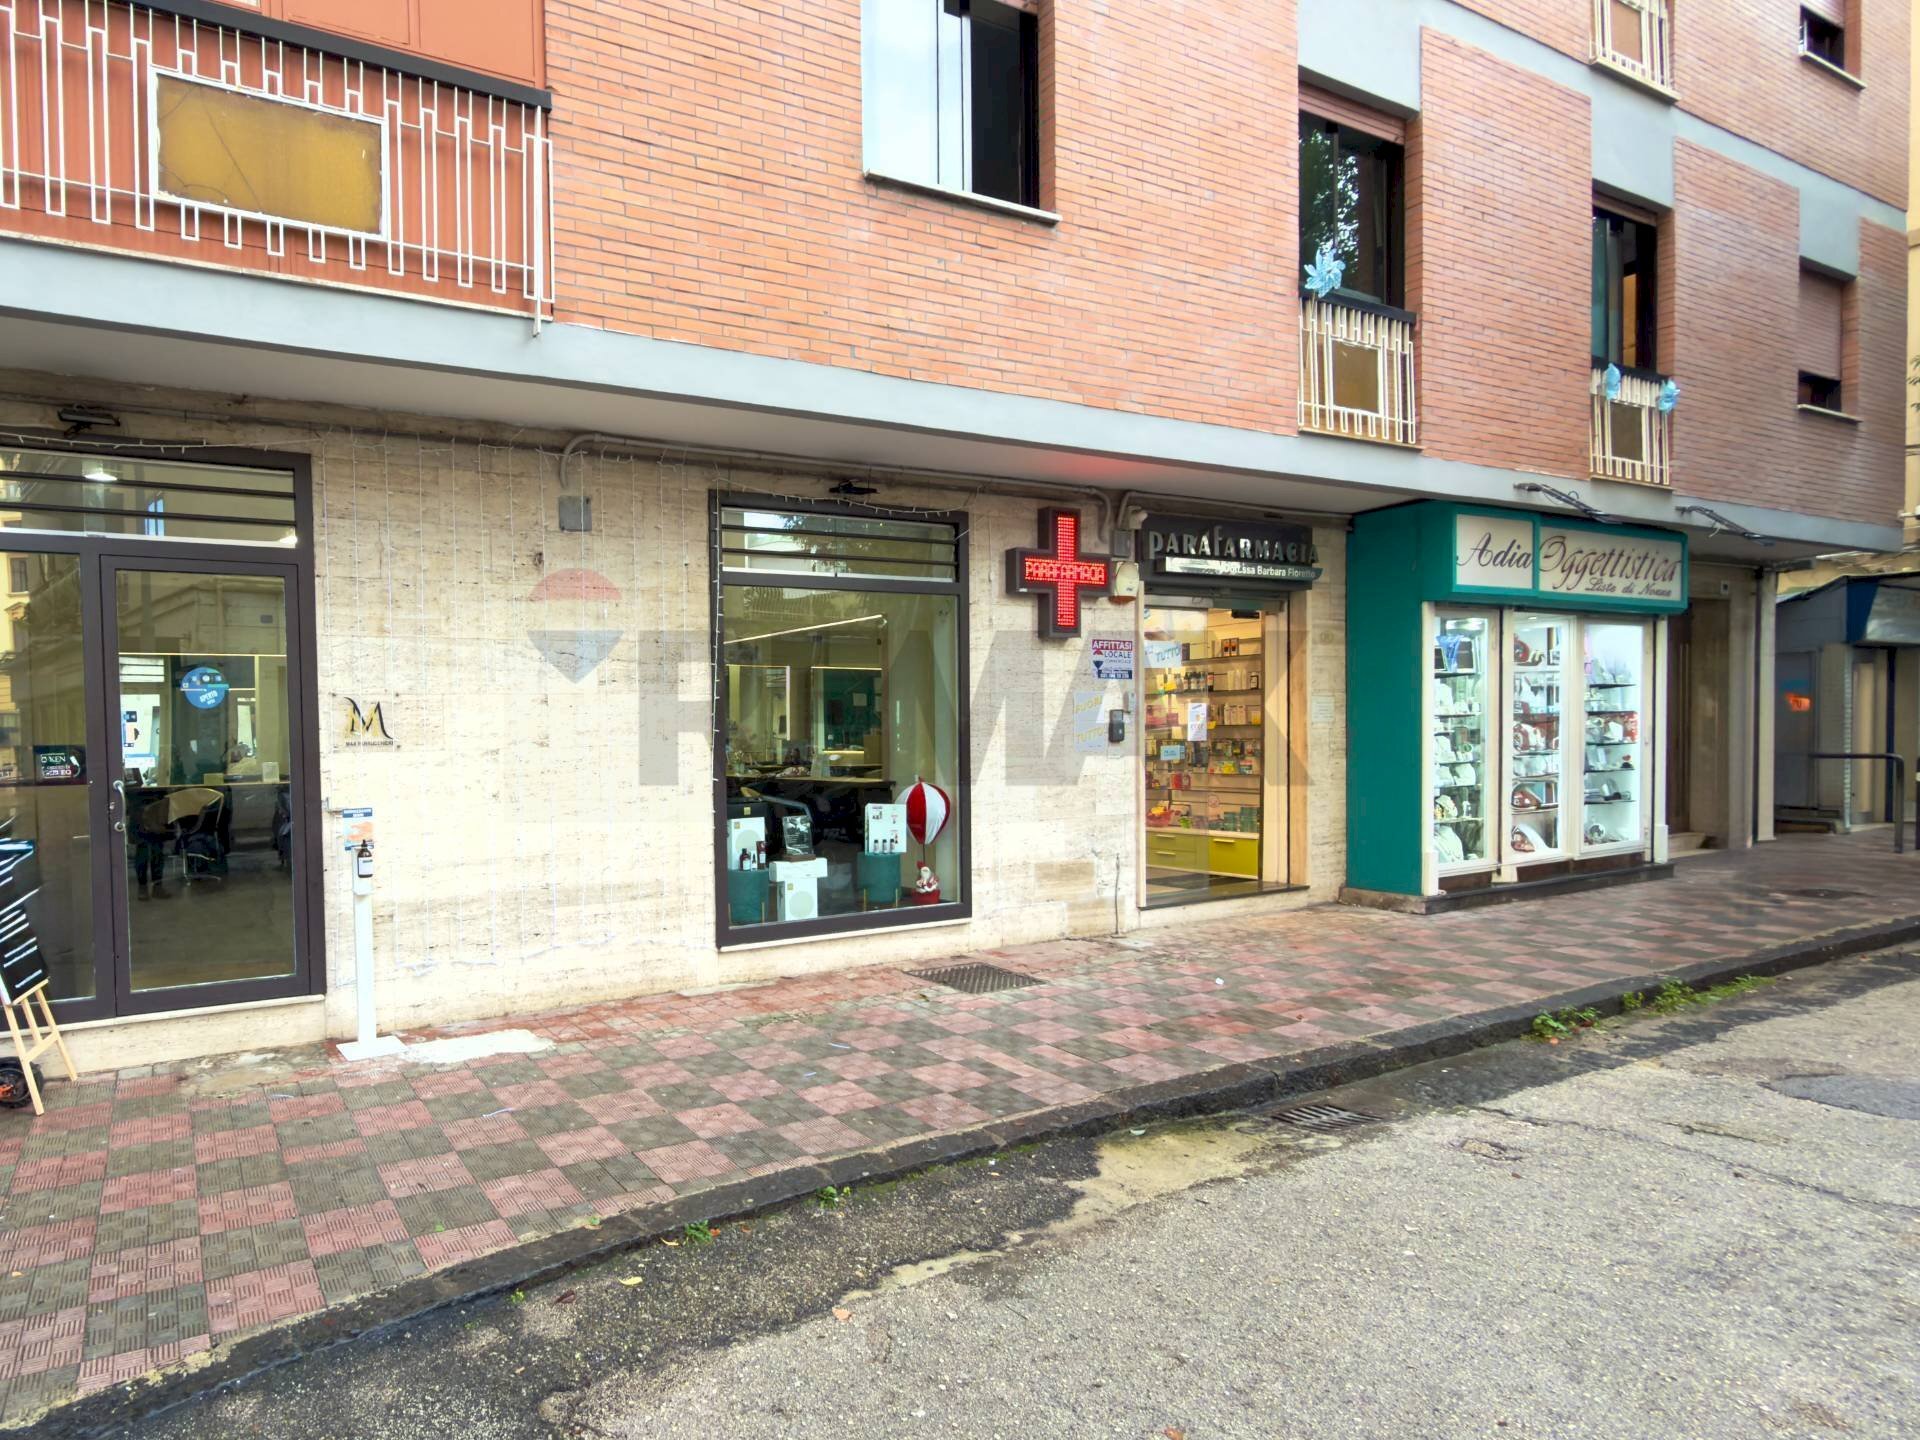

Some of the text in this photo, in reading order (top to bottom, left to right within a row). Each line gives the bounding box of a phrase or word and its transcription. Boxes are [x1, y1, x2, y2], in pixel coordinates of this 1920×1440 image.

[1456, 532, 1532, 568] Adia
[1538, 535, 1682, 590] Oggettistica
[1257, 565, 1287, 577] Barbara
[1622, 582, 1636, 594] di
[1092, 640, 1132, 651] AFFITTASI
[1104, 651, 1132, 659] LOCALE
